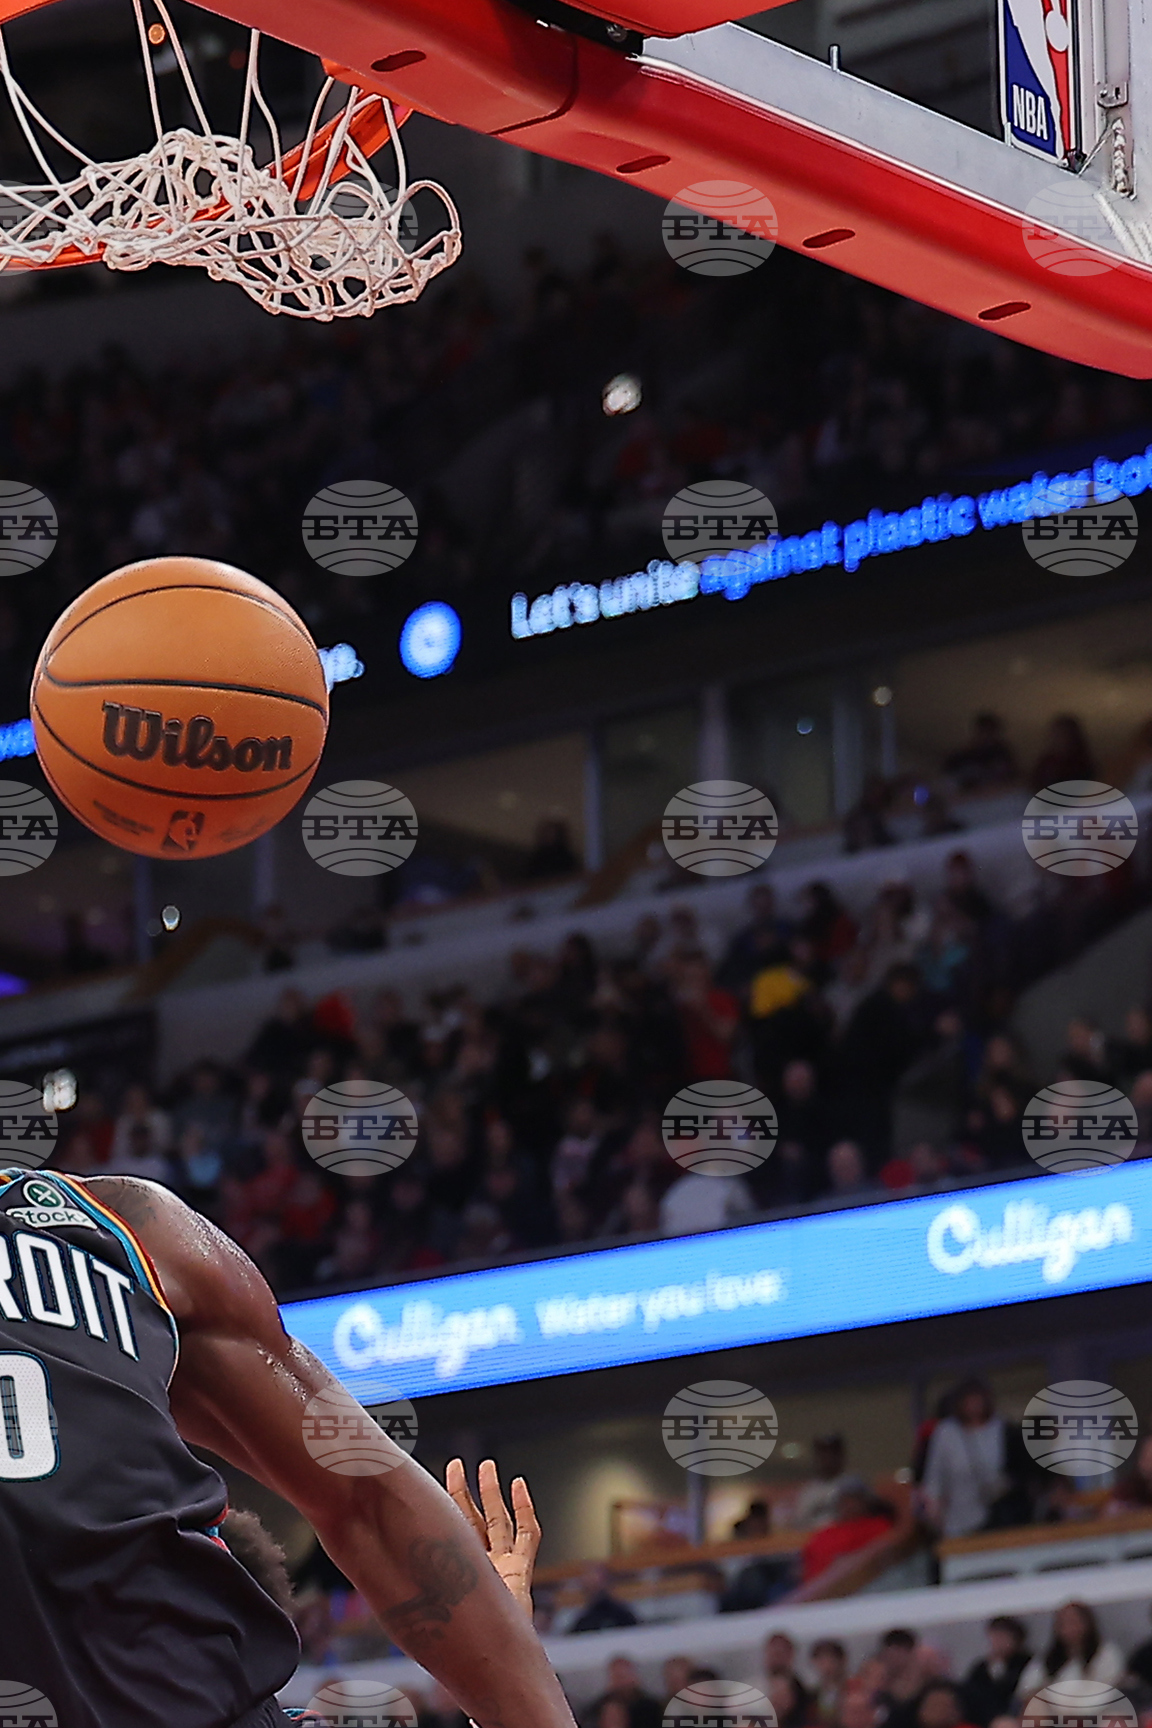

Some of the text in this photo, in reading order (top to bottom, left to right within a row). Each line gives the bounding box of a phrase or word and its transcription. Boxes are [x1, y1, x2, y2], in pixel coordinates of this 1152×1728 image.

[1012, 84, 1049, 141] NBA
[102, 700, 292, 772] Wilson
[927, 1198, 1134, 1284] Culligan
[333, 1299, 523, 1378] Culligan
